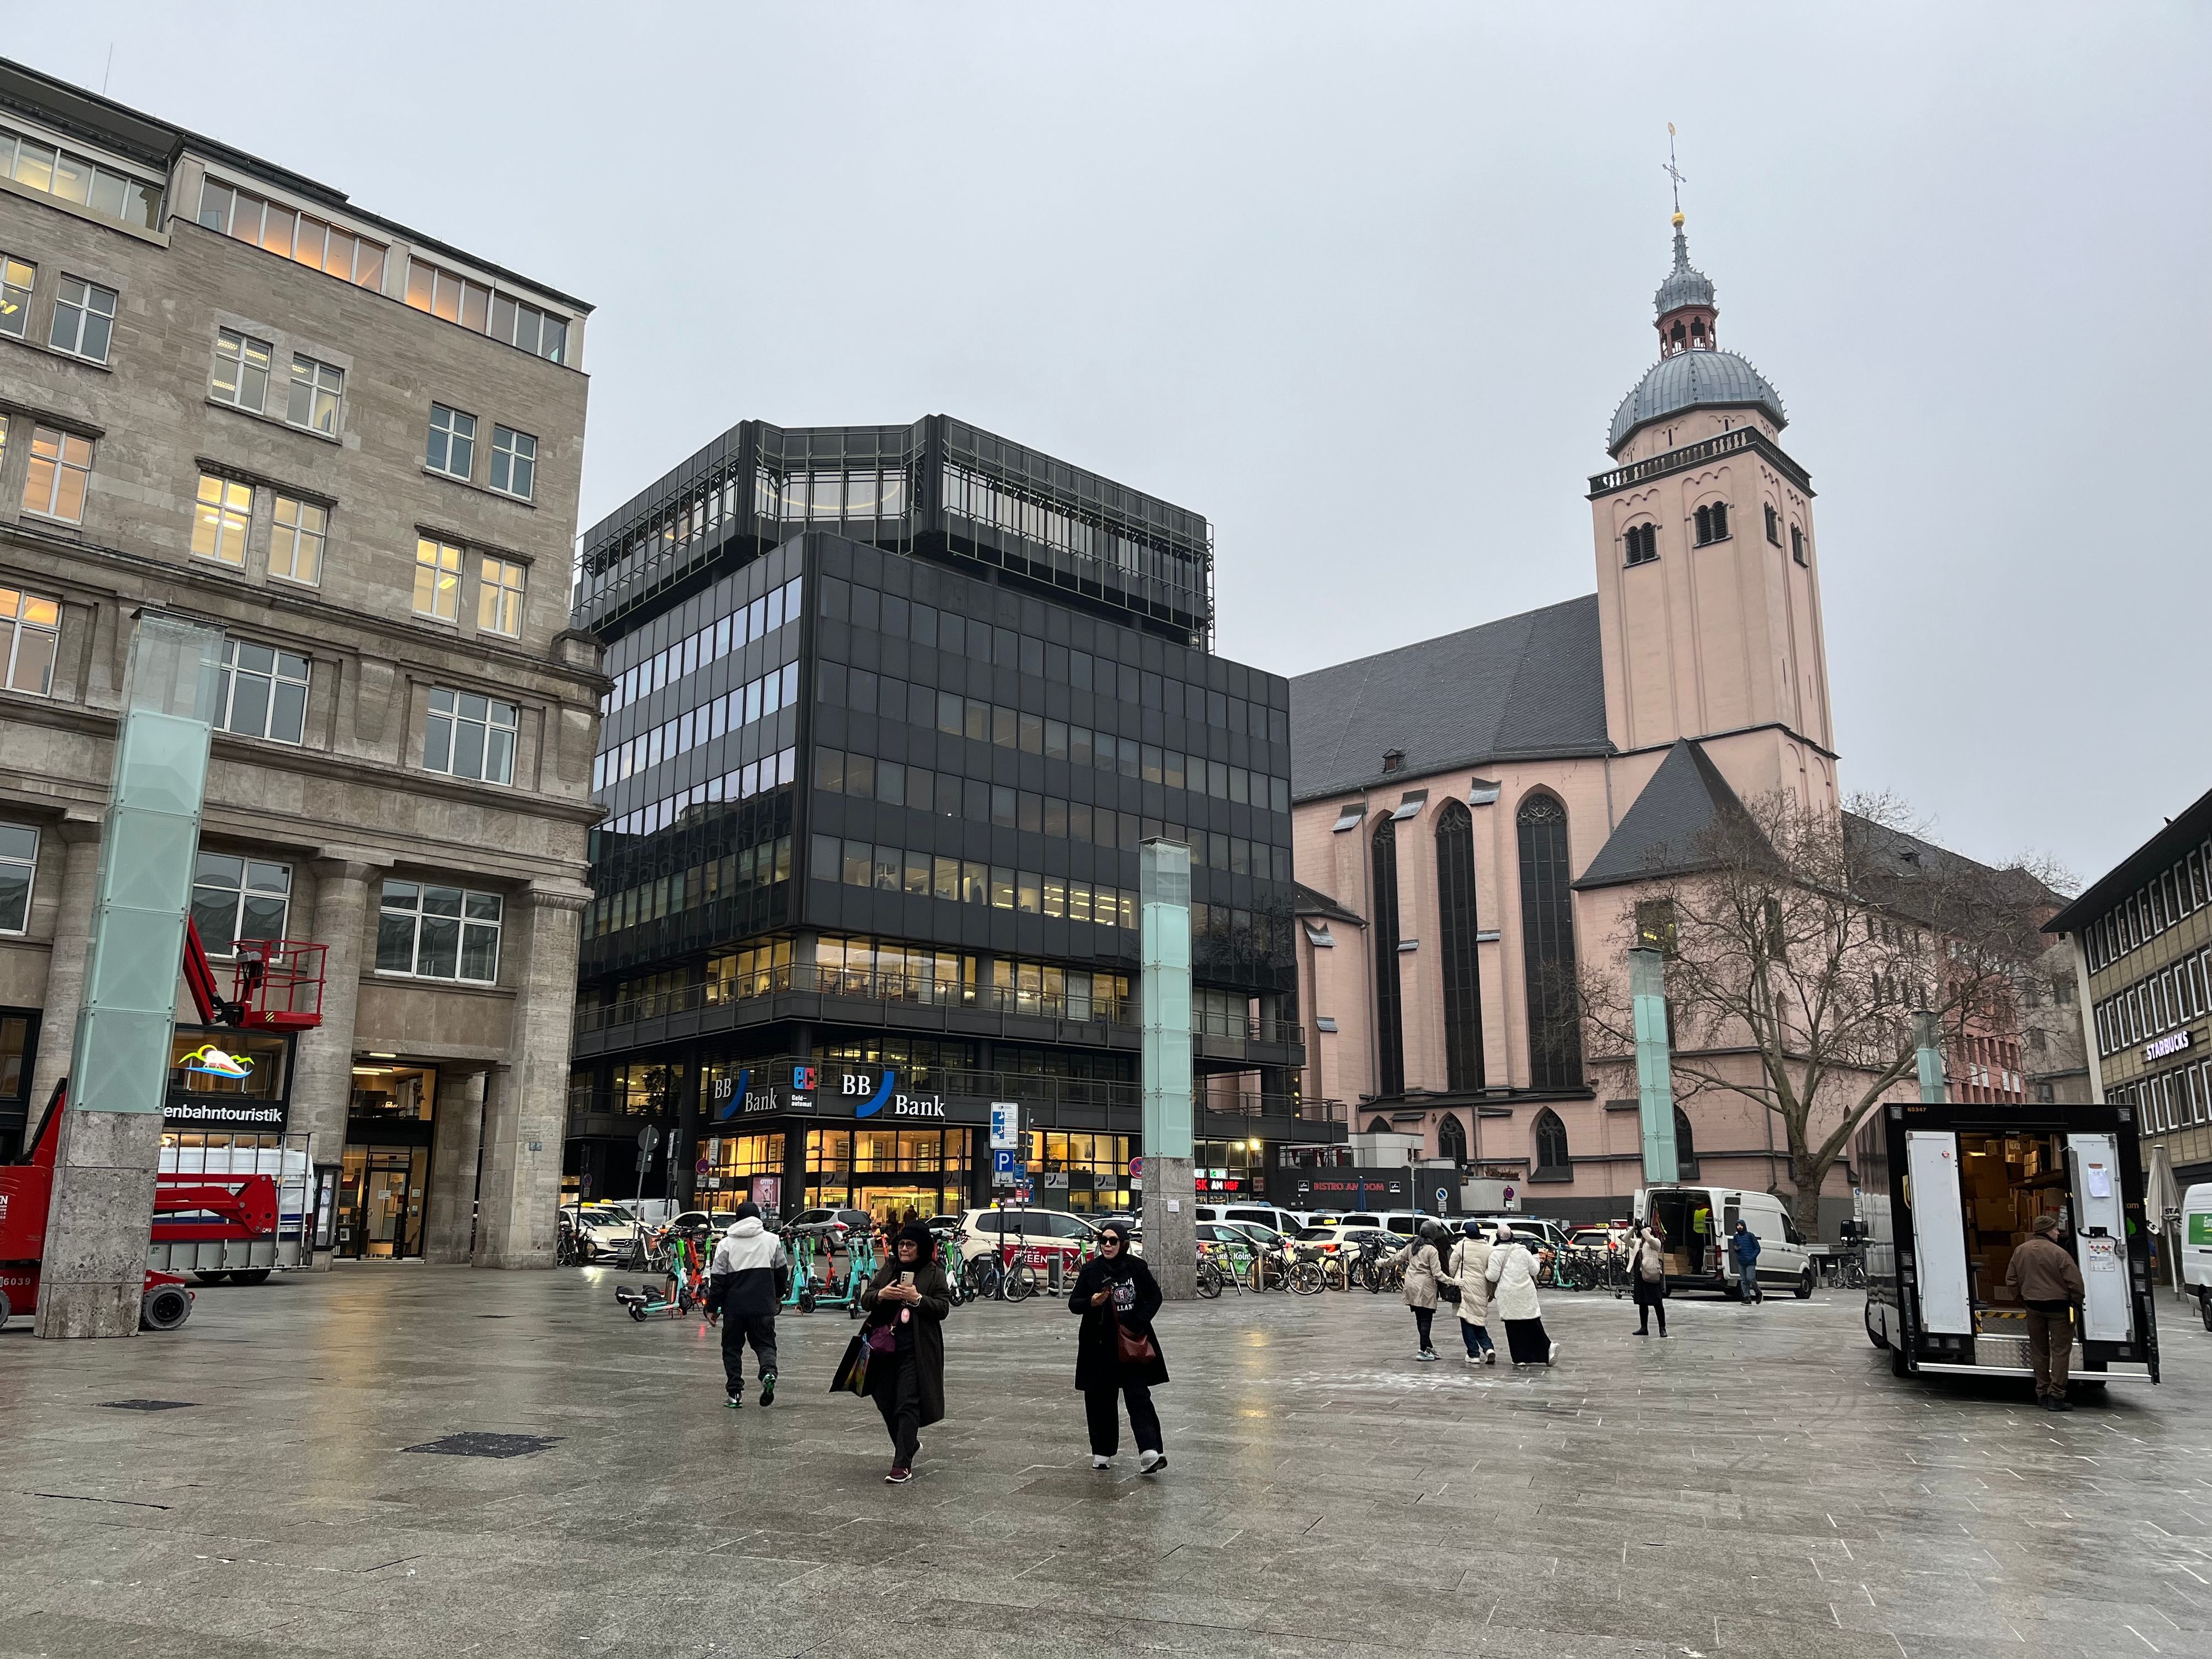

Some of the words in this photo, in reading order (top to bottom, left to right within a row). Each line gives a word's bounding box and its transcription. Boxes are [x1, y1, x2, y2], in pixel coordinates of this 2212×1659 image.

[2146, 1030, 2189, 1061] STARBUCKS
[714, 1078, 732, 1099] BB
[744, 1087, 778, 1112] Bank
[841, 1074, 871, 1095] BB
[894, 1094, 945, 1117] Bank
[164, 1104, 282, 1122] enbahntouristik
[999, 1153, 1009, 1171] P
[1211, 1180, 1223, 1190] AM
[1224, 1181, 1239, 1191] HBF
[1313, 1182, 1344, 1191] BISTRO
[1233, 1251, 1252, 1260] Köln!
[3, 1277, 31, 1286] 6039
